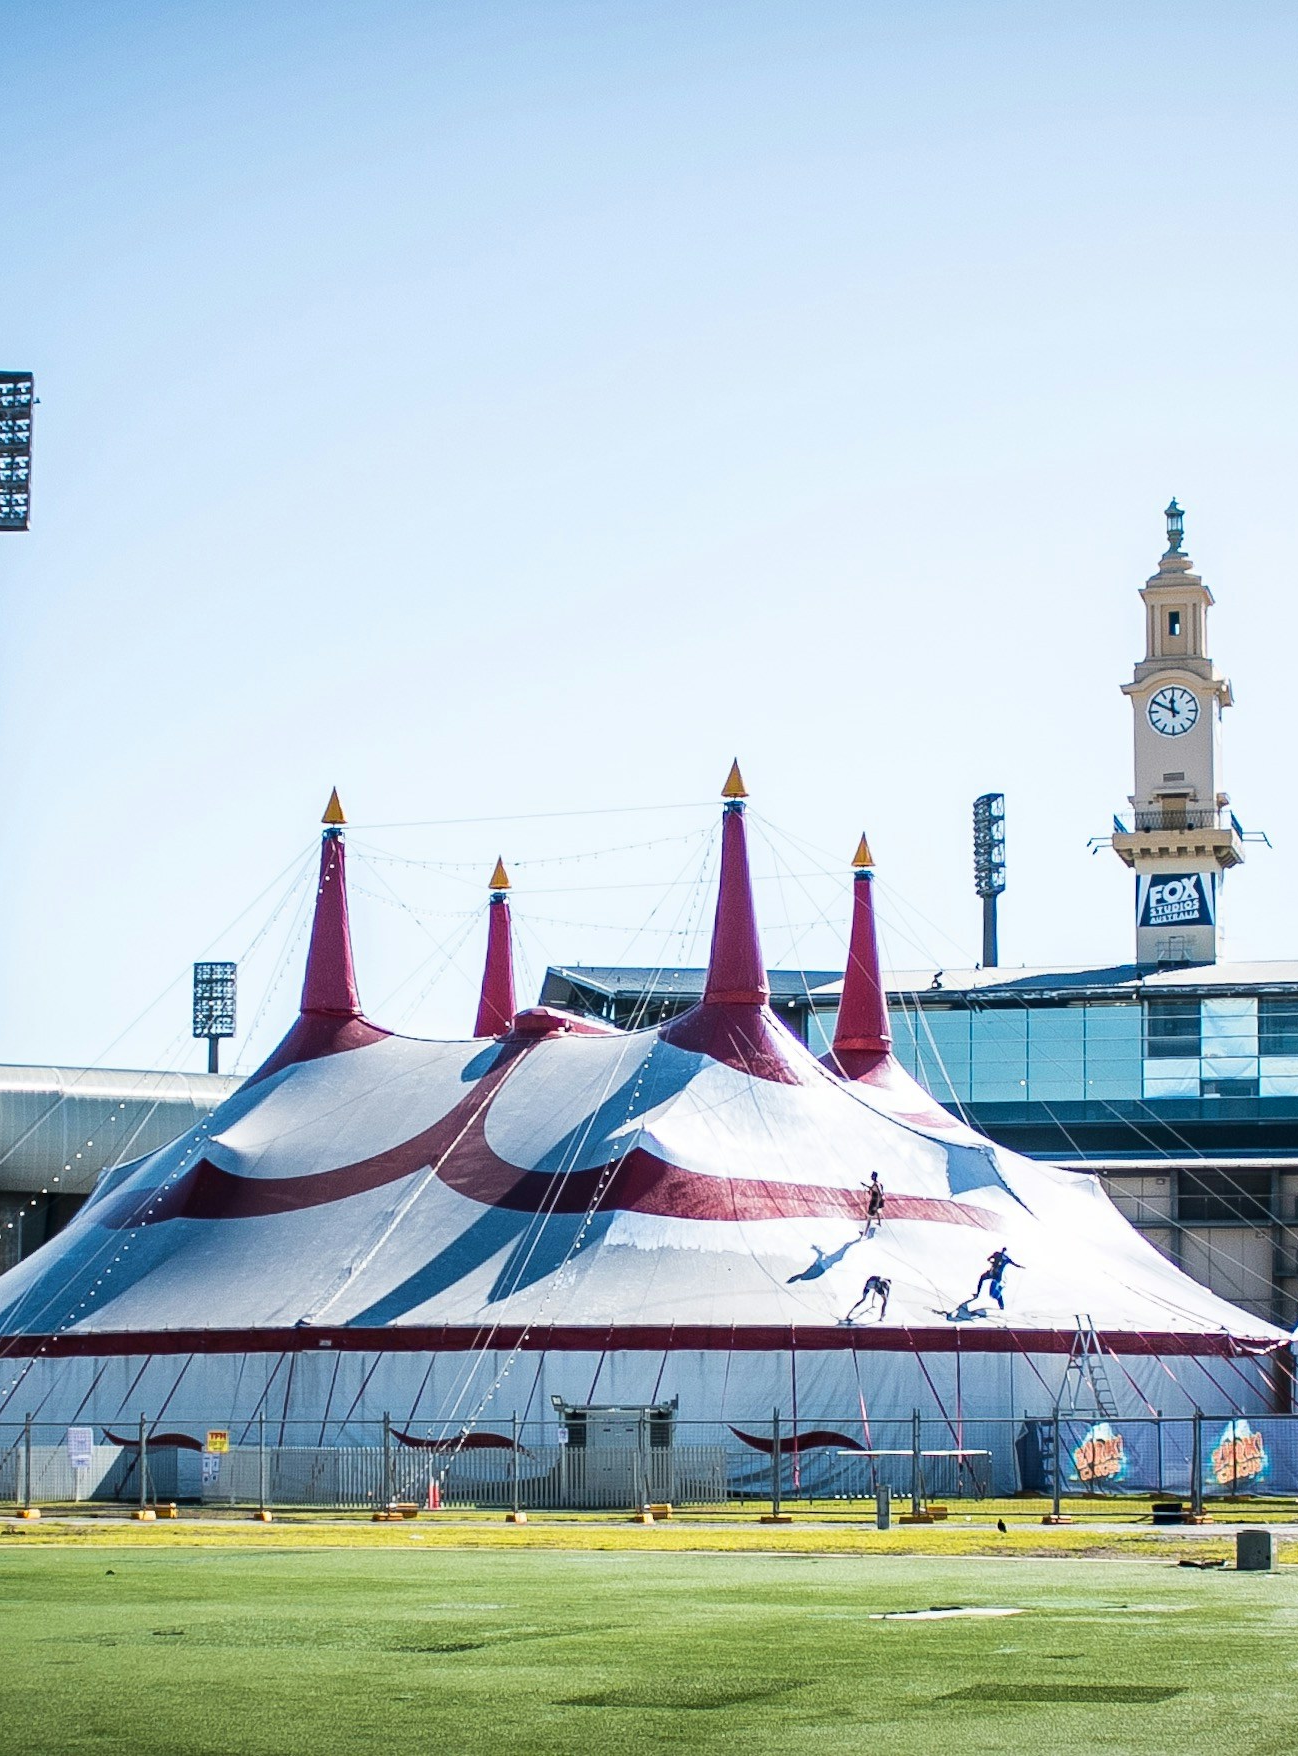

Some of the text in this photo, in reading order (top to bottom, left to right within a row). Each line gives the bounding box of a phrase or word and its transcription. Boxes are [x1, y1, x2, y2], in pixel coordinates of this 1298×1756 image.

[1149, 875, 1199, 908] FOX
[1149, 910, 1200, 924] AUSTRALIA
[1150, 899, 1200, 917] STUDIOS
